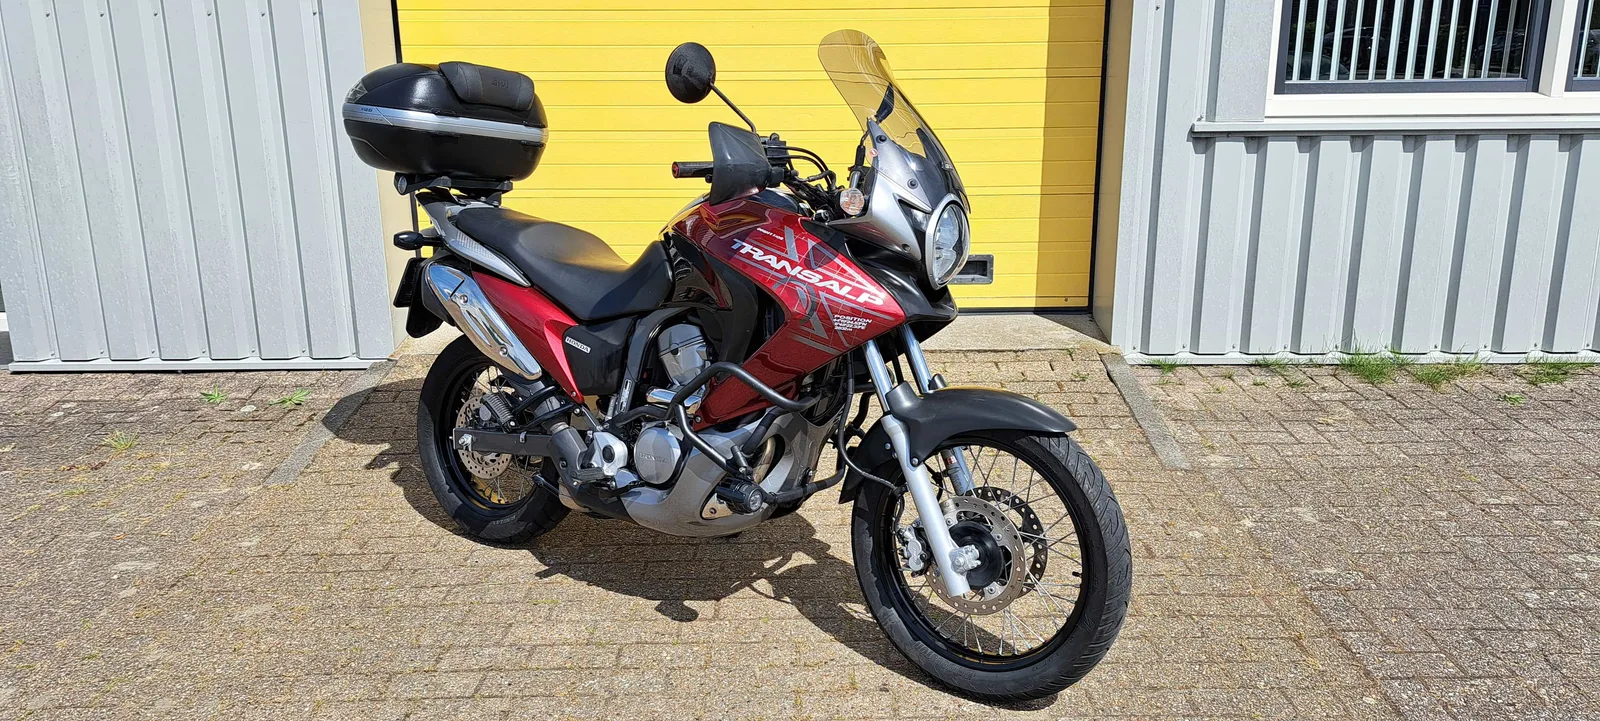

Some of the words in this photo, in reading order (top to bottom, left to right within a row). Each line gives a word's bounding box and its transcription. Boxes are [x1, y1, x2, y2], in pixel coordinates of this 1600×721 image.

[731, 238, 885, 306] TRANSALP
[833, 314, 873, 324] POSITION
[566, 338, 589, 353] HONDA
[639, 451, 668, 464] HONDA
